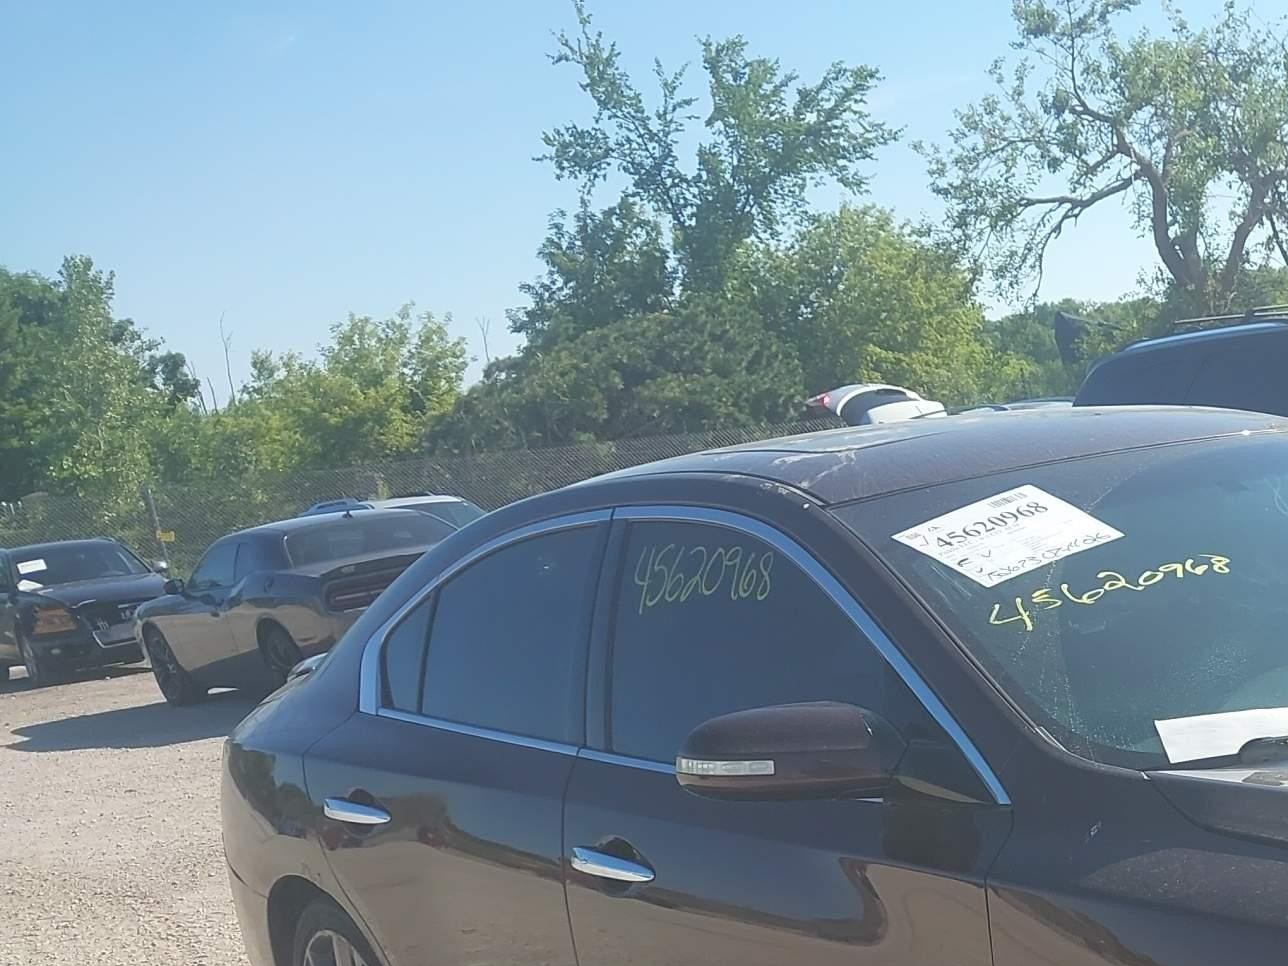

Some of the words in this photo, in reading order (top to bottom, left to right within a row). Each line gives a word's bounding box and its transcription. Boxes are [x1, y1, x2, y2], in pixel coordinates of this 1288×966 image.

[936, 500, 1050, 548] 45620968
[634, 543, 775, 615] 45620968
[988, 553, 1233, 632] 45620968
